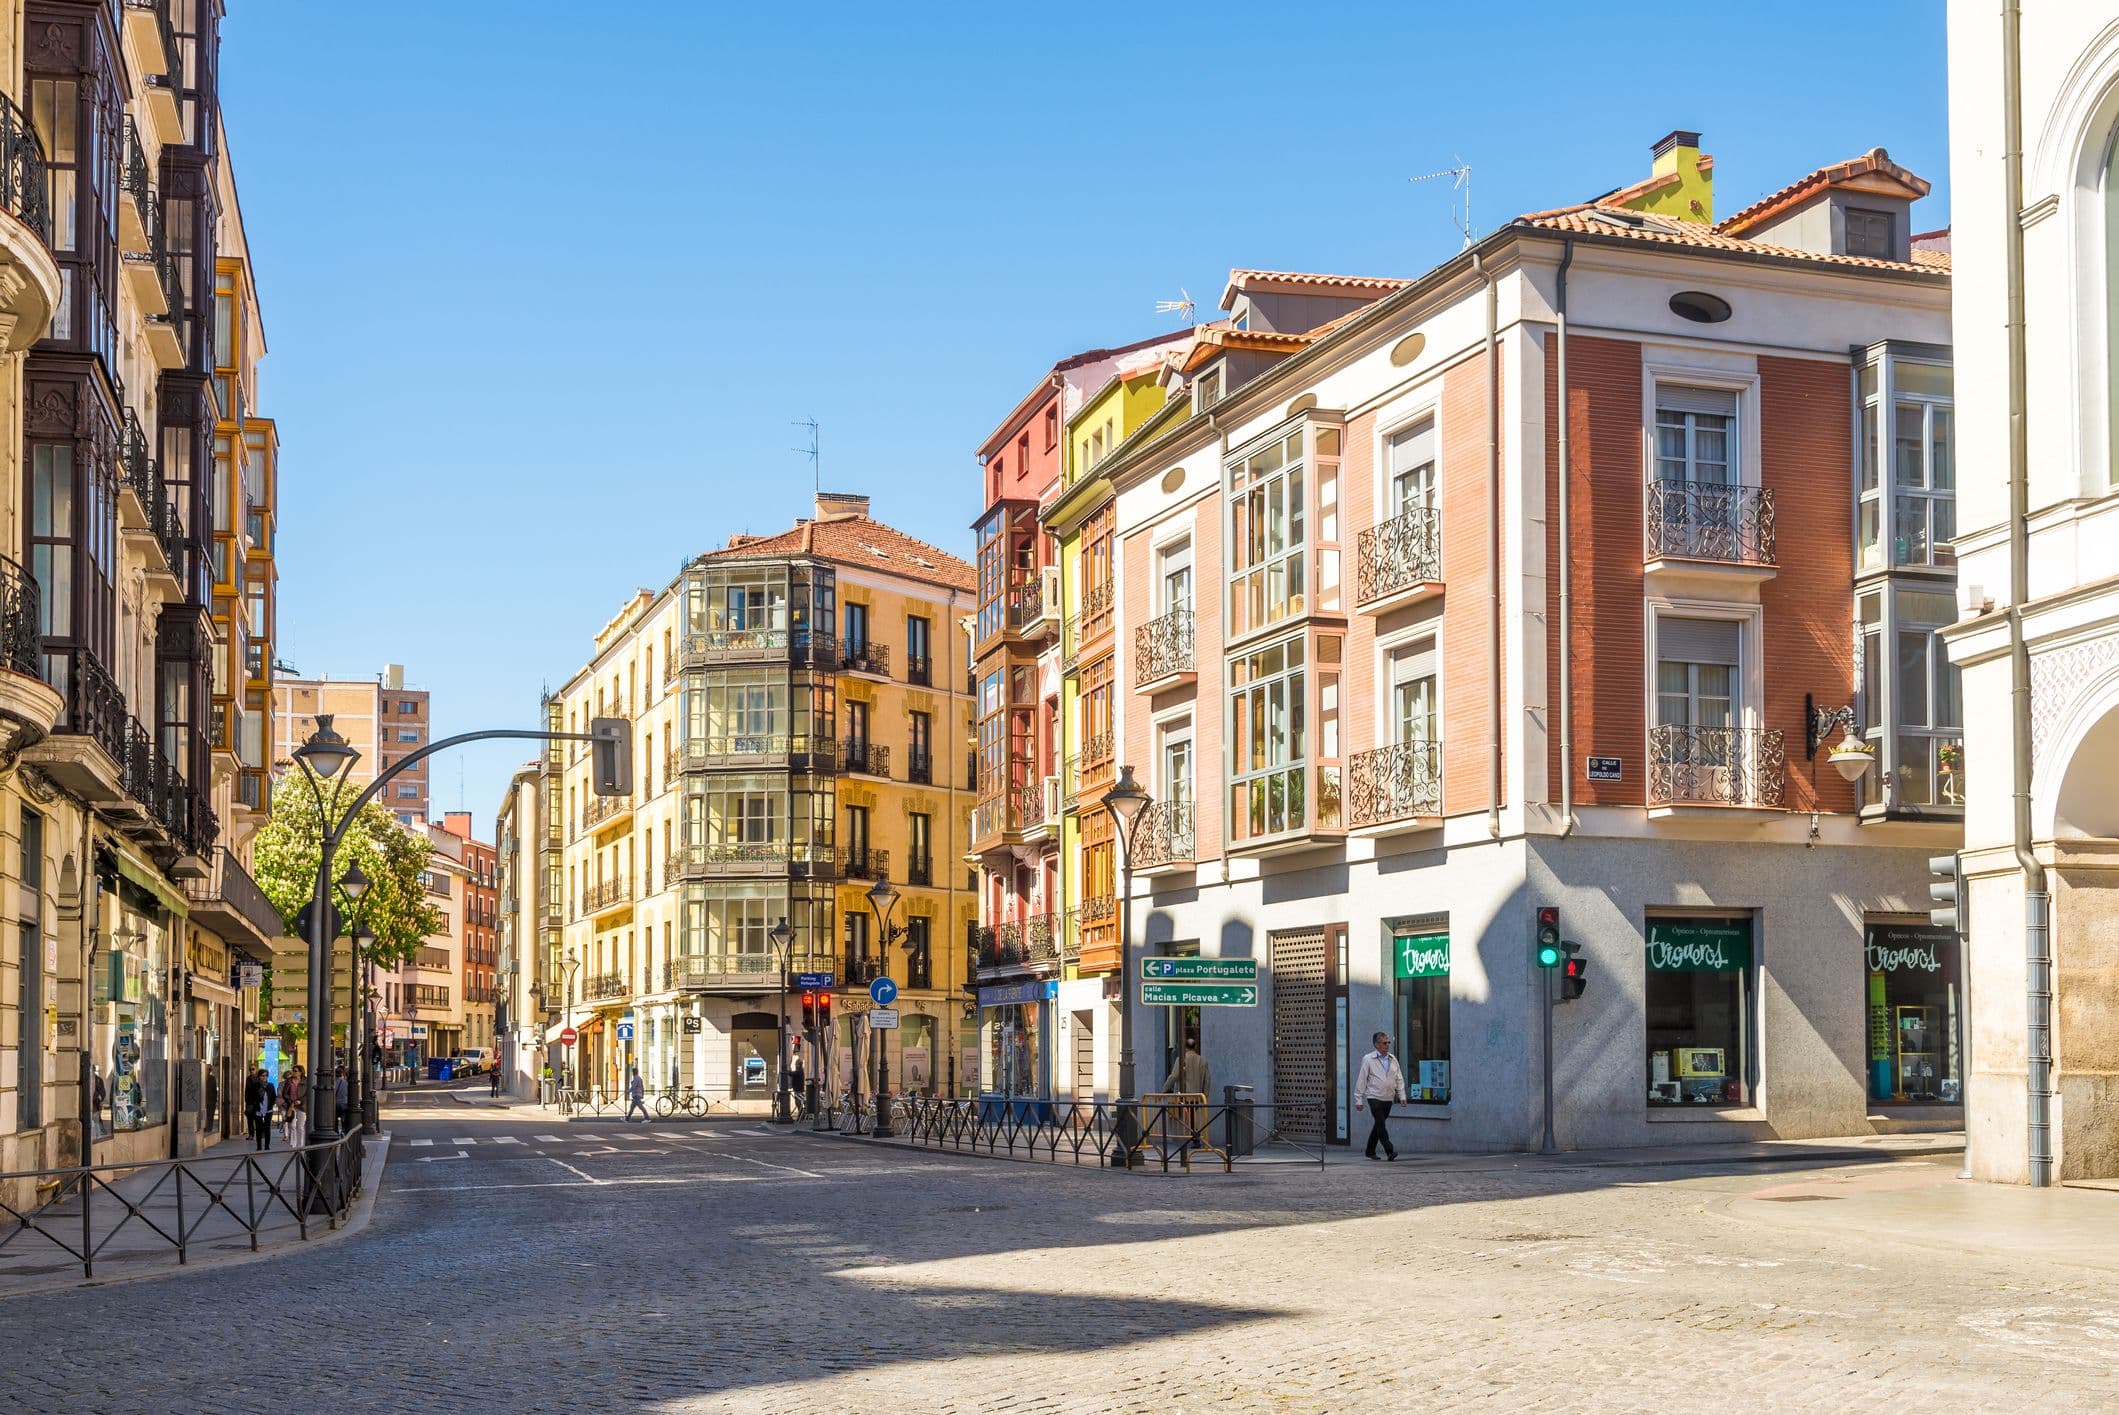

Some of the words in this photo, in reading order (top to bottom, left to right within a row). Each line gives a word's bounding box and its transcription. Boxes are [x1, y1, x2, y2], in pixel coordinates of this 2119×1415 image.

[1645, 927, 1729, 969] trigueros
[1864, 931, 1941, 972] trigueros
[1163, 964, 1172, 974] P
[1175, 966, 1194, 974] plaza
[1196, 965, 1255, 975] Portugalete
[1182, 994, 1218, 1002] Picavea
